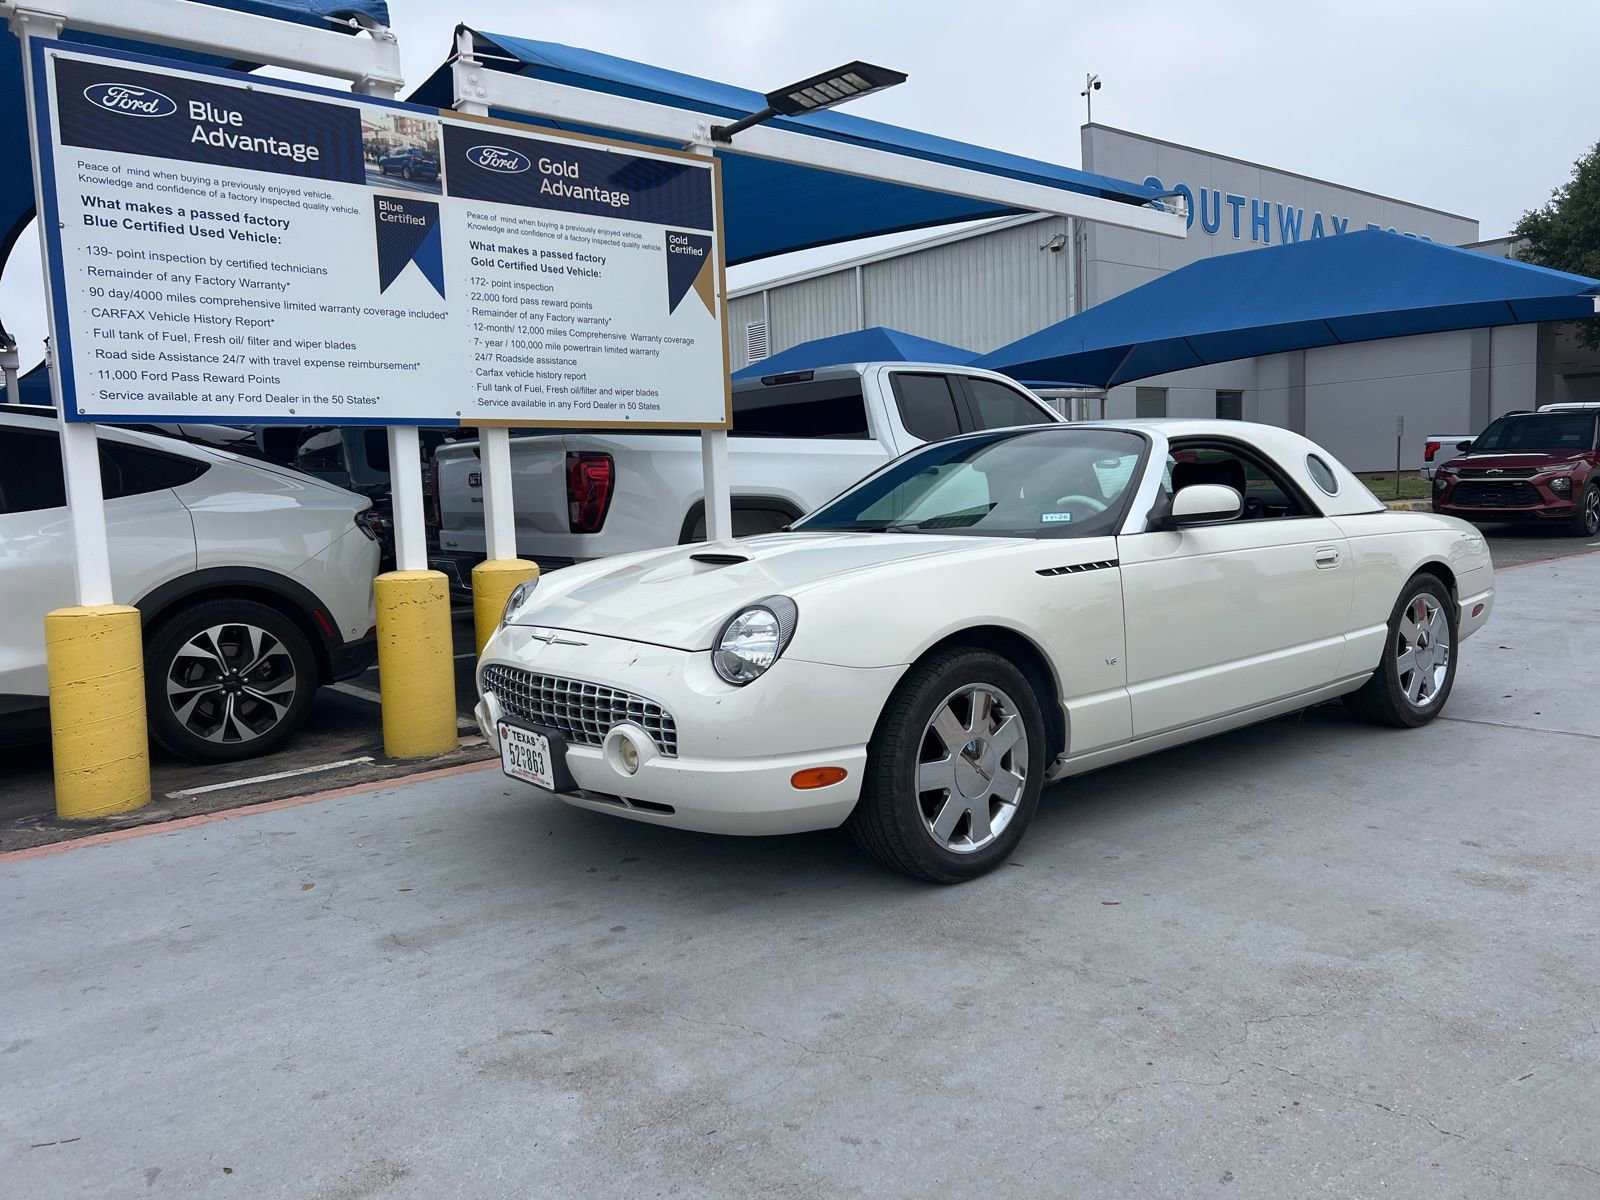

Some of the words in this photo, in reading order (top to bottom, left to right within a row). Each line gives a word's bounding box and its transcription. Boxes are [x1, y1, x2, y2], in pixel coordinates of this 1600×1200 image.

[102, 84, 159, 114] Ford
[189, 100, 243, 127] Blue
[191, 125, 320, 163] Advantage
[479, 148, 519, 170] Ford
[538, 158, 579, 179] Gold
[78, 161, 109, 172] Peace
[112, 165, 121, 174] of
[127, 168, 150, 177] mind
[153, 171, 178, 181] when
[181, 174, 211, 187] buying
[222, 181, 266, 193] previously
[268, 186, 301, 197] enjoyed
[303, 191, 334, 200] vehicle.
[79, 174, 133, 189] Knowledge
[156, 185, 206, 197] confidence
[209, 190, 218, 198] of
[228, 192, 258, 205] factory
[260, 196, 300, 208] inspected
[303, 203, 329, 213] quality
[331, 206, 361, 215] vehicle.
[540, 178, 630, 207] Advantage
[81, 195, 121, 210] What
[126, 202, 173, 216] makes
[178, 209, 186, 217] a
[190, 210, 240, 223] passed
[244, 213, 290, 231] factory
[379, 201, 404, 213] Blue
[379, 212, 426, 226] Certified
[84, 214, 118, 228] Blue
[123, 218, 185, 235] Certified
[189, 225, 225, 239] Used
[229, 229, 281, 245] Vehicle:
[669, 235, 688, 245] Gold
[670, 244, 703, 256] Certified
[86, 246, 113, 257] 139-
[117, 249, 146, 260] point
[149, 251, 207, 265] inspection
[210, 256, 223, 269] by
[226, 260, 268, 270] certified
[271, 262, 328, 275] technicians
[470, 241, 496, 252] What
[498, 245, 530, 256] makes
[540, 251, 573, 260] passed
[576, 252, 606, 265] factory
[88, 266, 153, 280] Remainder
[157, 272, 167, 281] of
[171, 275, 192, 286] any
[195, 275, 236, 289] Factory
[471, 257, 495, 268] Gold
[498, 260, 538, 272] Certified
[541, 264, 564, 274] Used
[566, 266, 602, 278] Vehicle:
[492, 280, 512, 289] point
[514, 281, 554, 292] inspection
[90, 287, 105, 297] 90
[109, 288, 163, 301] day/4000
[167, 293, 197, 304] miles
[200, 297, 281, 309] comprehensive
[284, 301, 317, 312] limited
[319, 305, 361, 316] warranty
[364, 308, 406, 319] coverage
[471, 292, 500, 302] 22,000
[502, 294, 518, 304] ford
[520, 298, 540, 306] pass
[542, 300, 568, 308] reward
[570, 301, 593, 310] points
[92, 308, 145, 320] CARFAX
[148, 311, 190, 323] Vehicle
[194, 314, 232, 327] History
[472, 307, 518, 319] Remainder
[520, 311, 528, 319] of
[530, 313, 544, 322] any
[547, 313, 575, 325] Factory
[94, 328, 115, 339] Full
[119, 330, 144, 340] tank
[148, 331, 159, 341] of
[162, 332, 191, 343] Fuel,
[194, 334, 226, 344] Fresh
[229, 336, 245, 345] oil/
[248, 336, 270, 346] filter
[273, 339, 292, 347] and
[295, 339, 322, 350] wiper
[325, 340, 357, 350] blades
[485, 340, 504, 349] year
[511, 340, 543, 350] 100,000
[545, 343, 561, 351] mile
[564, 345, 603, 353] powertrain
[604, 346, 628, 355] limited
[630, 349, 660, 358] warranty
[96, 349, 127, 360] Road
[131, 351, 156, 361] side
[159, 352, 219, 363] Assistance
[223, 354, 246, 364] 24/7
[249, 356, 270, 365] with
[273, 357, 301, 366] travel
[304, 360, 345, 369] expense
[98, 370, 138, 381] 11,000
[141, 371, 168, 381] Ford
[172, 372, 200, 382] Pass
[203, 373, 245, 384] Reward
[248, 375, 281, 385] Points
[476, 368, 504, 377] Carfax
[506, 370, 534, 379] vehicle
[536, 371, 562, 381] history
[564, 373, 587, 382] report
[100, 390, 144, 401] Service
[148, 392, 198, 402] available
[202, 393, 213, 402] at
[215, 395, 235, 405] any
[238, 393, 262, 403] Ford
[266, 394, 299, 403] Dealer
[302, 395, 311, 404] in
[313, 395, 329, 404] the
[332, 395, 344, 404] 50
[477, 383, 492, 392] Full
[495, 384, 512, 392] tank
[514, 384, 522, 393] of
[547, 385, 569, 394] Fresh
[571, 386, 597, 395] oil/filter
[599, 388, 613, 396] and
[615, 388, 634, 397] wiper
[636, 389, 659, 397] blades
[478, 398, 509, 407] Service
[511, 400, 547, 408] available
[549, 400, 556, 408] in
[558, 402, 572, 410] any
[574, 401, 591, 409] Ford
[593, 401, 618, 410] Dealer
[628, 402, 637, 410] 50
[639, 402, 661, 411] States
[512, 731, 536, 747] TEXAS
